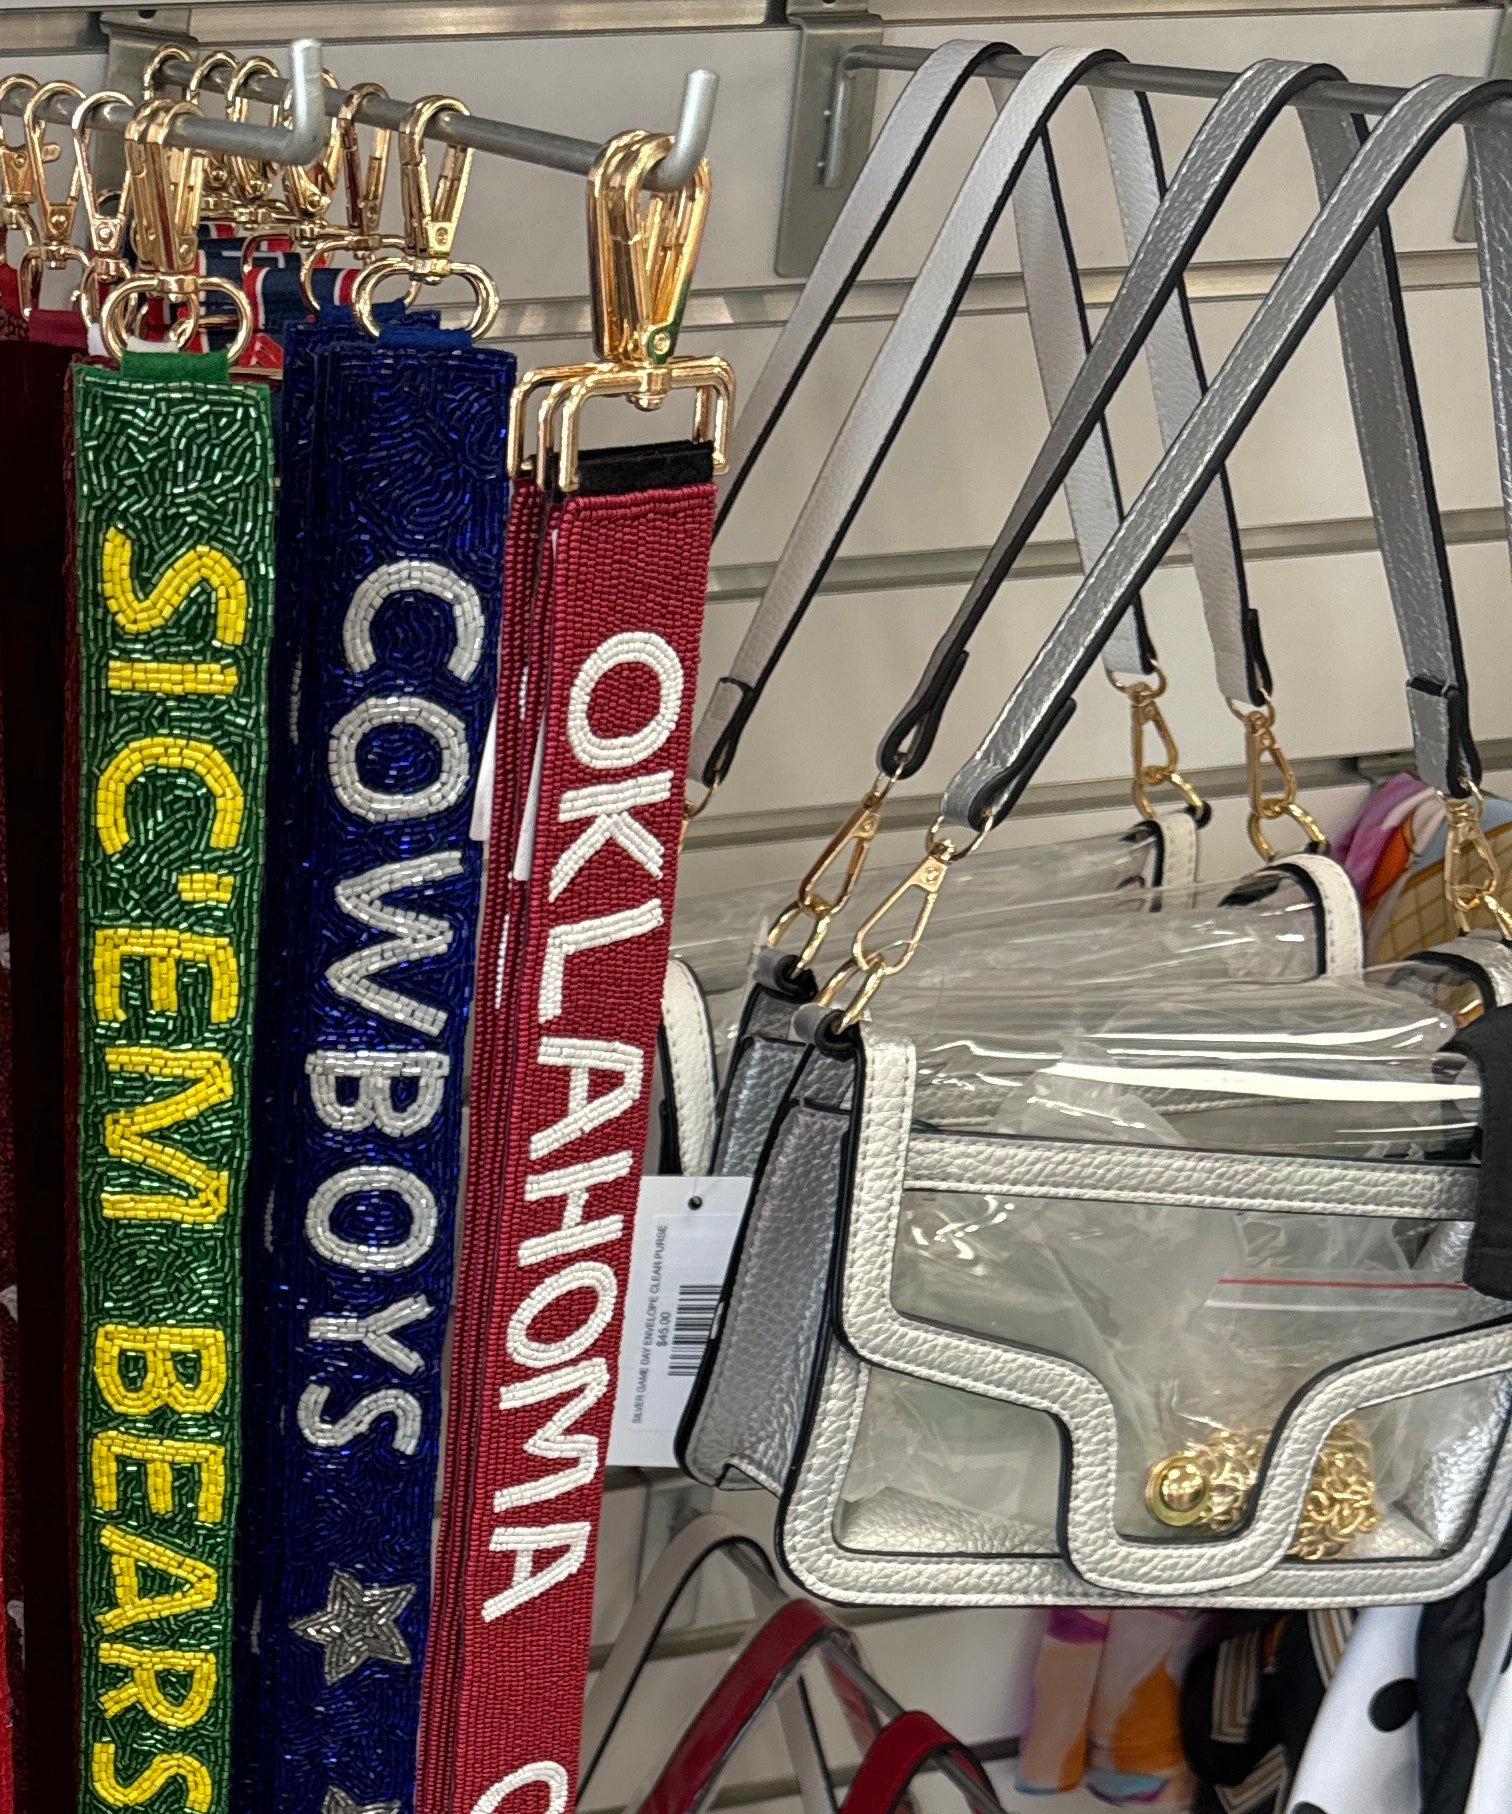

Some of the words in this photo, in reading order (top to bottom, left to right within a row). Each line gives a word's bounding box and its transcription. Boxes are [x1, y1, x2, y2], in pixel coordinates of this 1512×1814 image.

[296, 559, 485, 1456] COWBOYS
[482, 631, 683, 1622] OKLAHOMA
[655, 1224, 668, 1258] PURSE
[650, 1259, 663, 1295] CLEAR
[643, 1296, 658, 1347] ENVELOPE
[656, 1311, 672, 1347] $45.00
[641, 1347, 652, 1367] DAY
[637, 1367, 649, 1394] GAME
[632, 1394, 646, 1425] SILVER
[90, 1323, 228, 1813] BEARS
